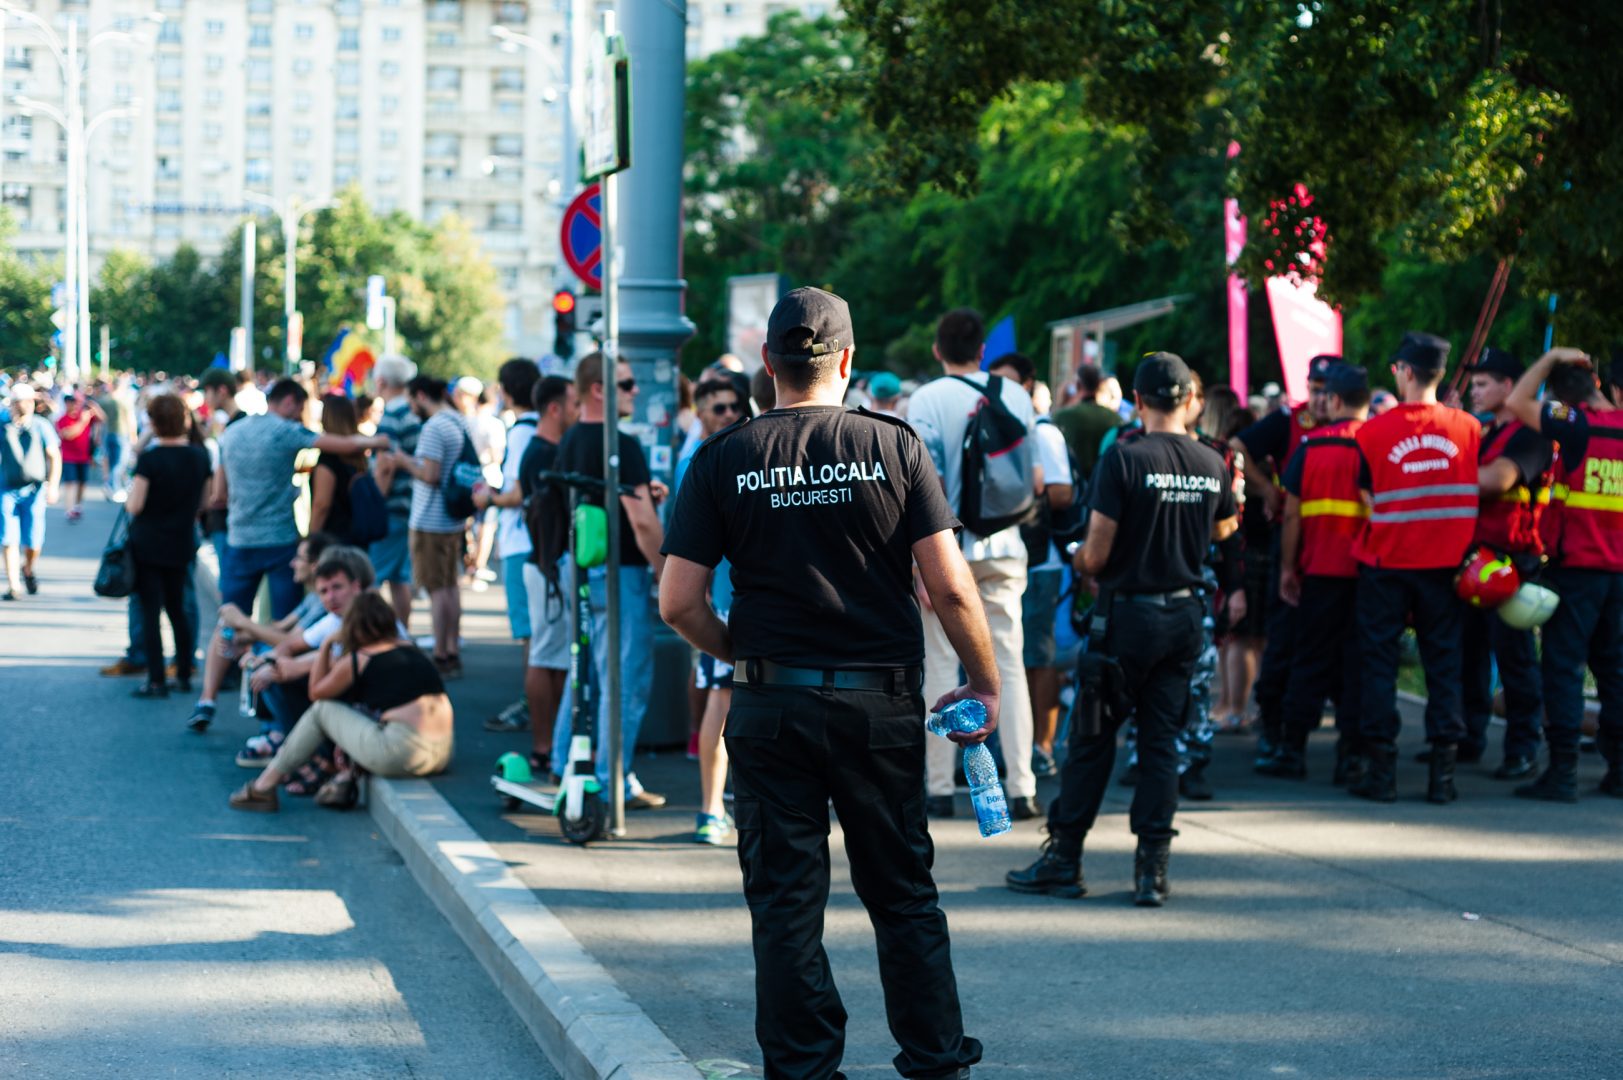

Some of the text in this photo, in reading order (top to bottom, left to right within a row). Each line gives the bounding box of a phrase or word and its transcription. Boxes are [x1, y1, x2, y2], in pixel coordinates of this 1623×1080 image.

[737, 461, 886, 494] POLITIA LOCALA
[771, 487, 852, 509] BUCURESTI
[1161, 490, 1203, 503] BCURESTI
